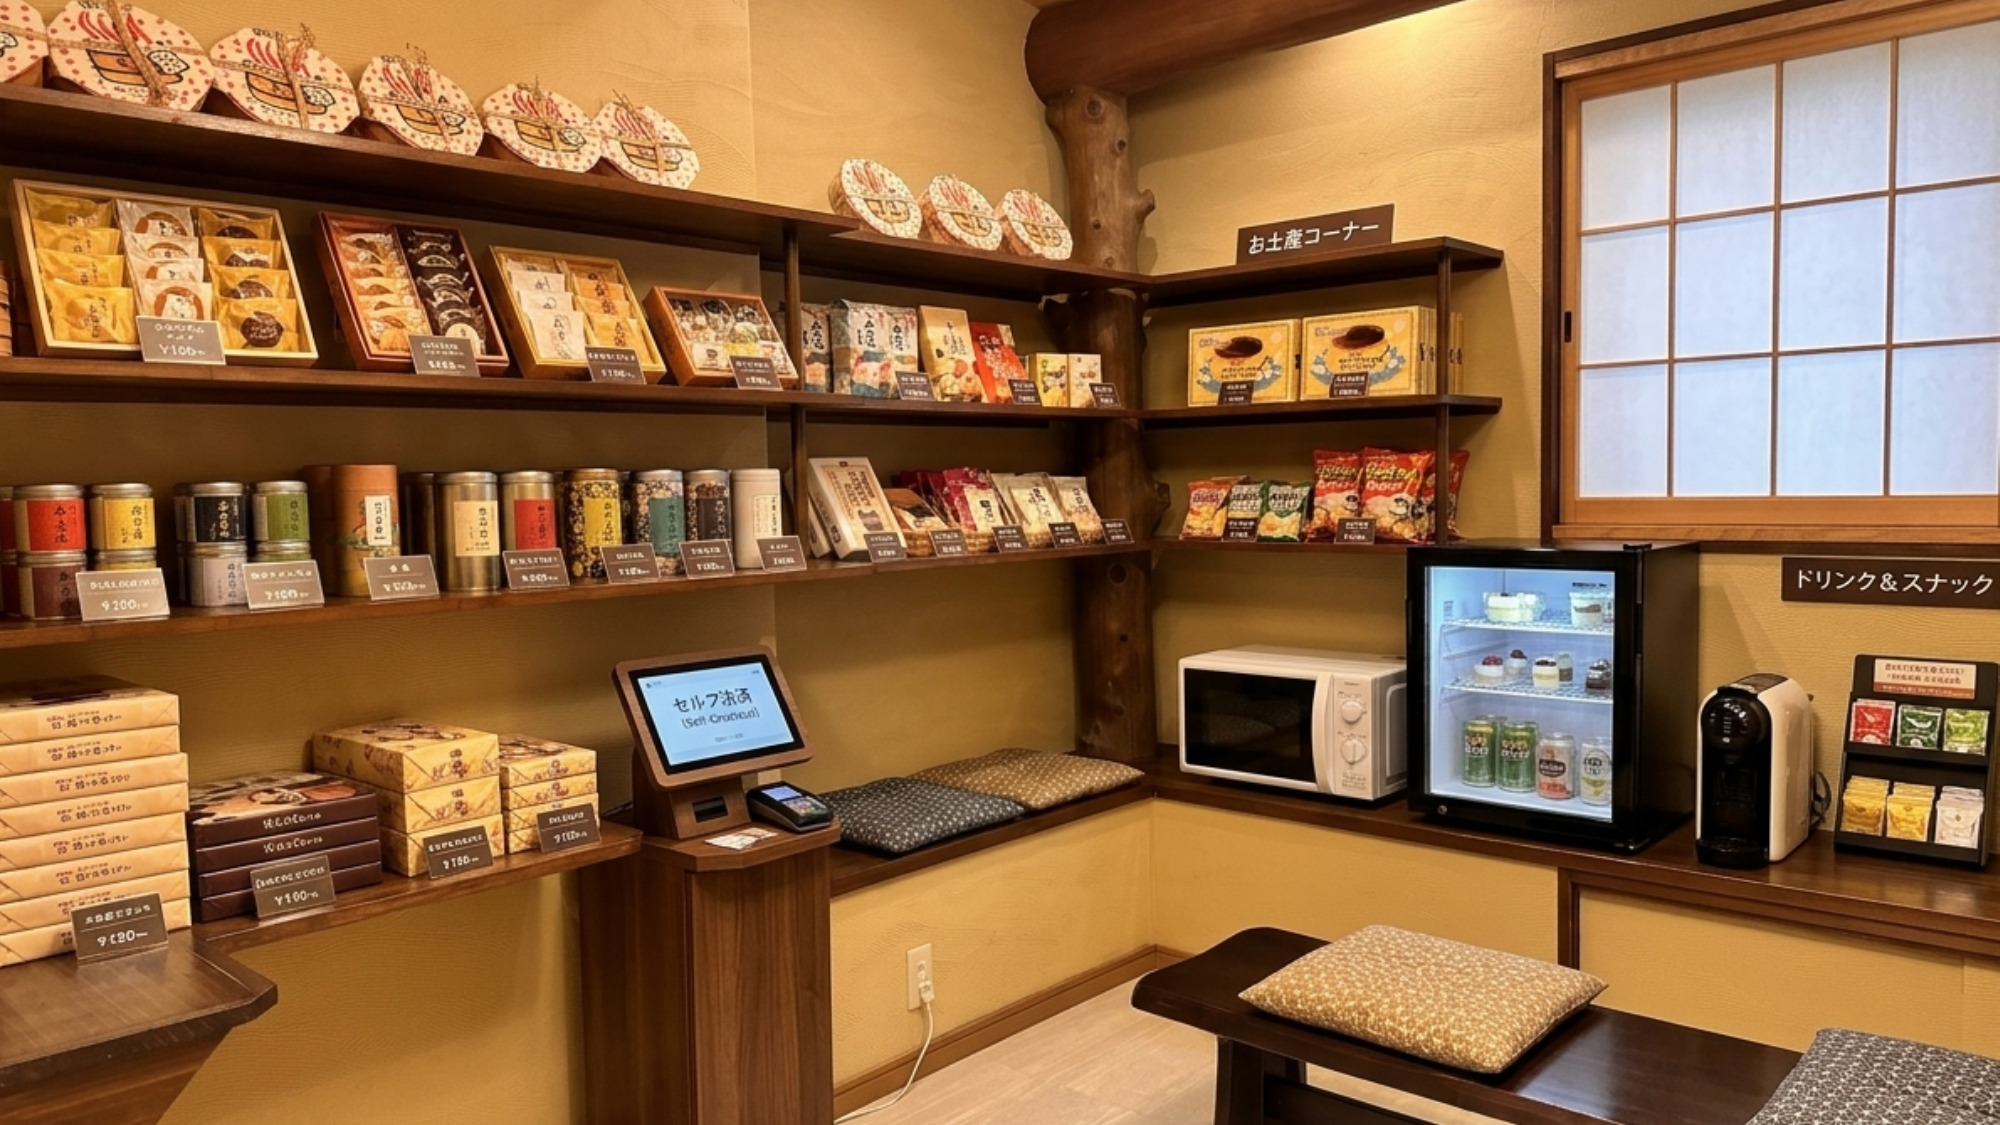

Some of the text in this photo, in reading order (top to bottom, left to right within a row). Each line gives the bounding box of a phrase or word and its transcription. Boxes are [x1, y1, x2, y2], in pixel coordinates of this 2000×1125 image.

[1248, 220, 1380, 255] お土産コーナー
[1797, 568, 1994, 596] ドリンク&スナック
